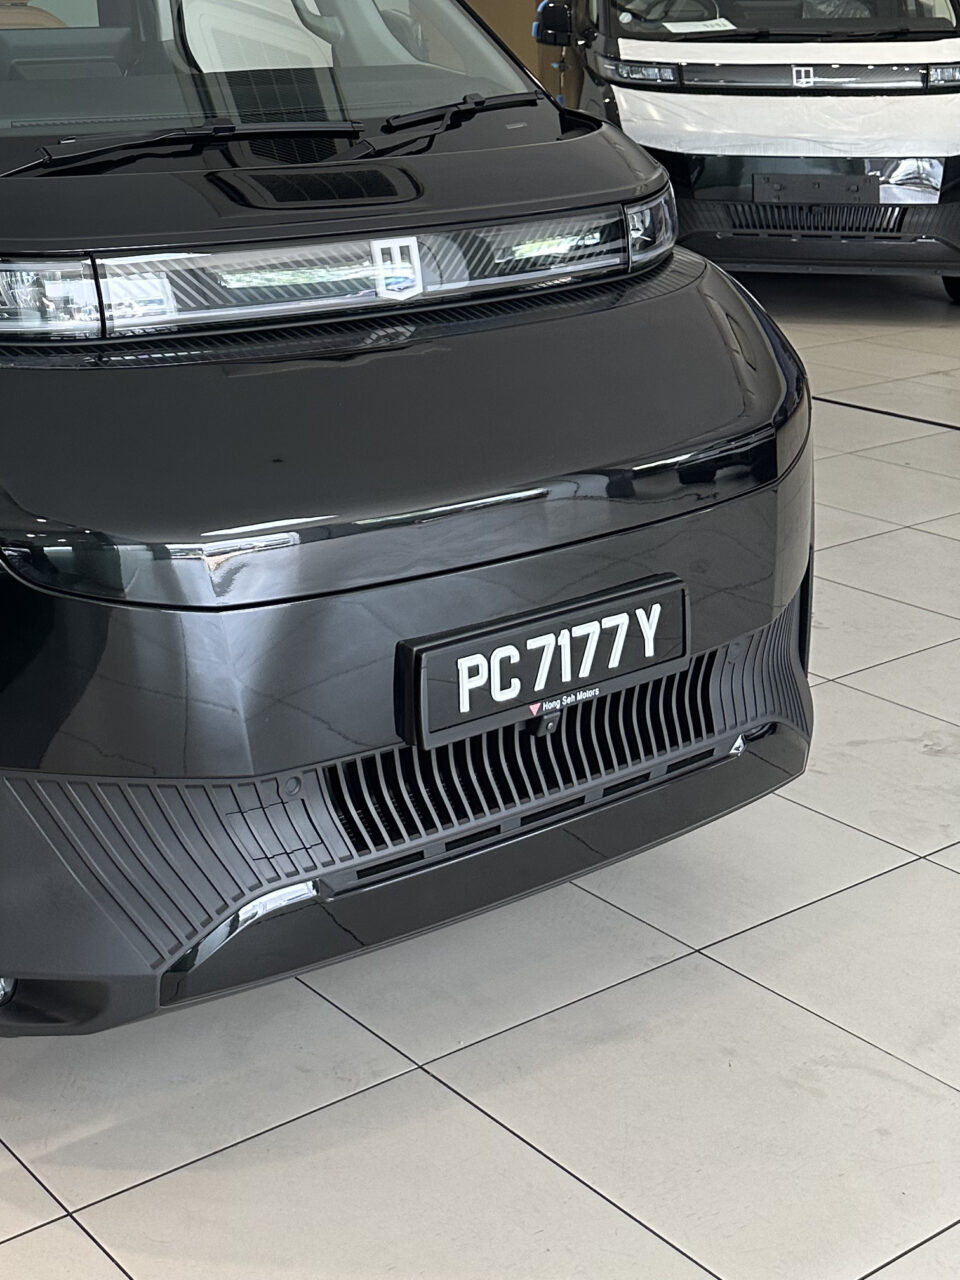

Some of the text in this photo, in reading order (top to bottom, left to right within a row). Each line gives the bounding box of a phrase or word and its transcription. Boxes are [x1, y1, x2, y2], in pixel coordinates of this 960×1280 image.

[457, 603, 661, 713] PC 7177 Y
[542, 687, 600, 712] Hong Seh Motors
